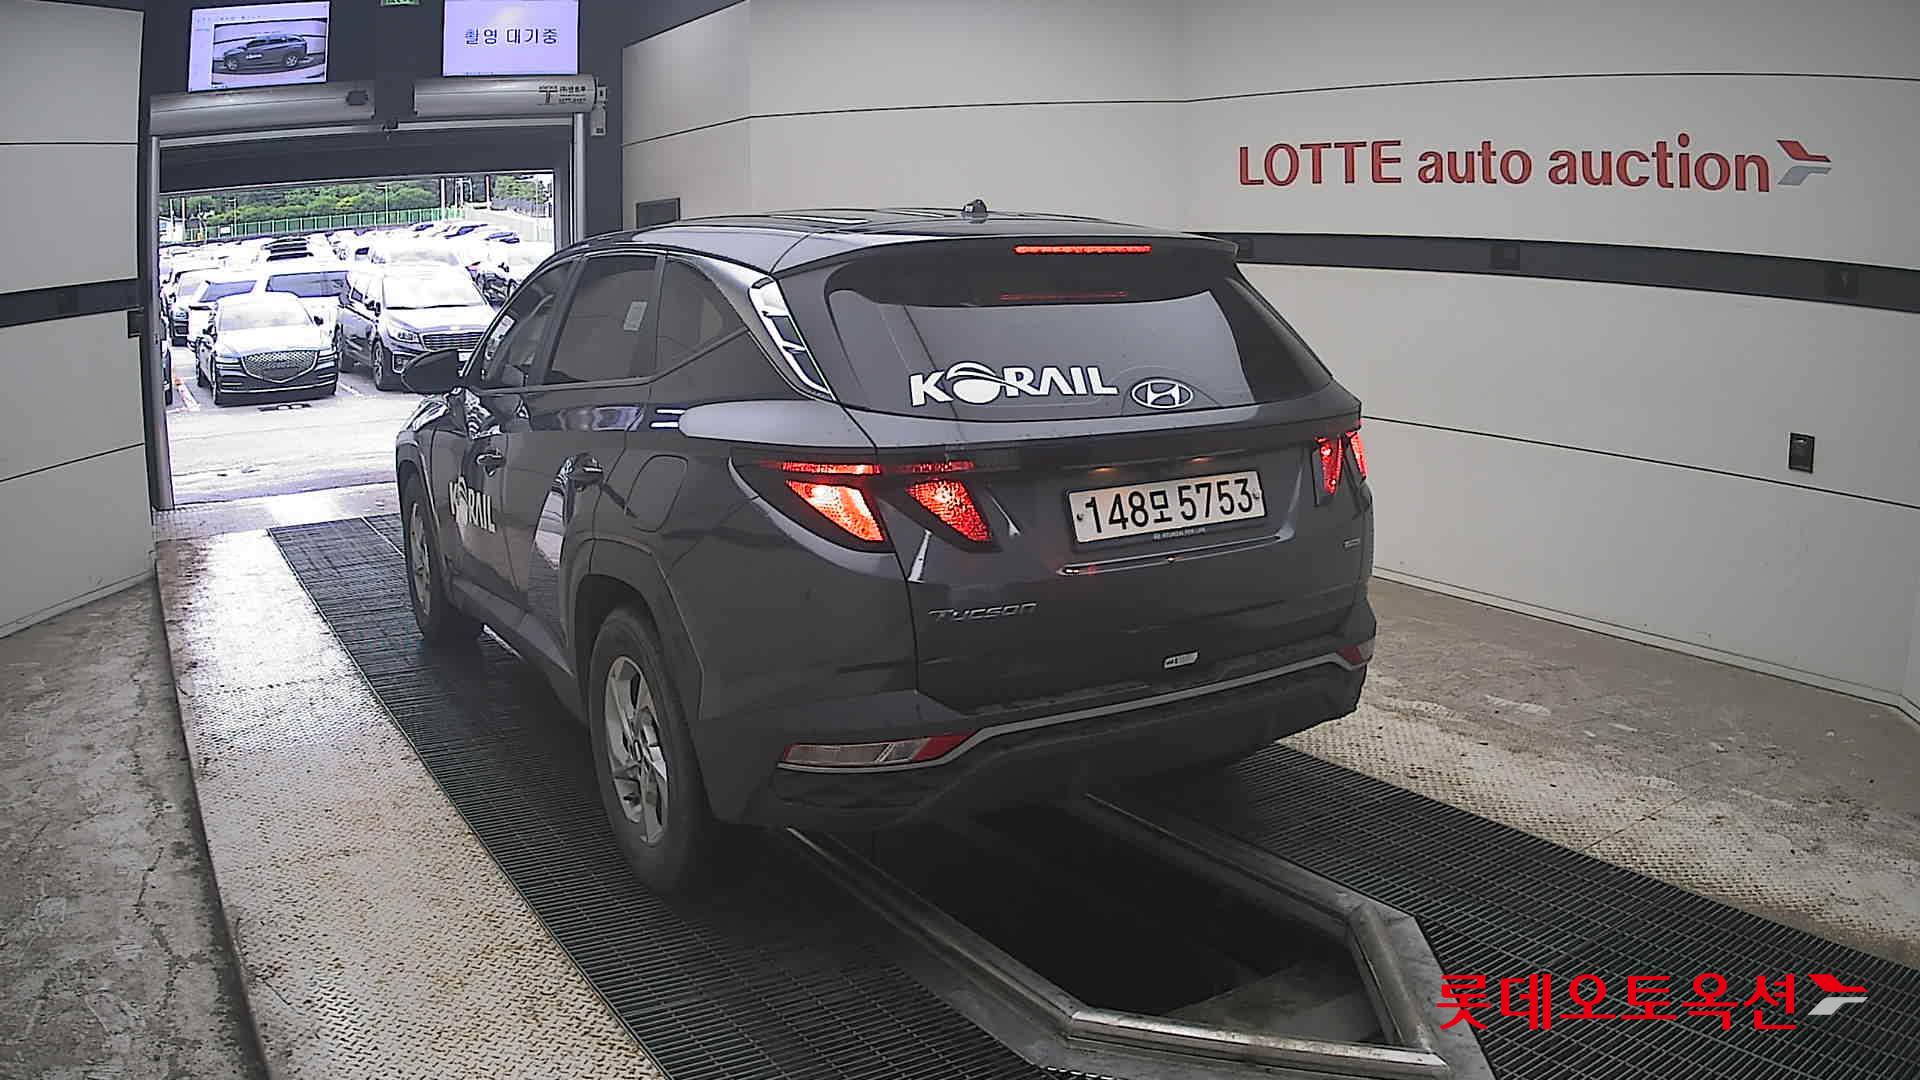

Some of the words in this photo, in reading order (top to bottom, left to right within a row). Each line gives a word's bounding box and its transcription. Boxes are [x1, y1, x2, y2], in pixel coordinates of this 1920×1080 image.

[505, 28, 558, 45] 대기중
[1239, 140, 1402, 187] LOTTE
[1417, 141, 1534, 185] auto
[1547, 132, 1771, 193] auction
[909, 361, 1119, 407] KORAIL
